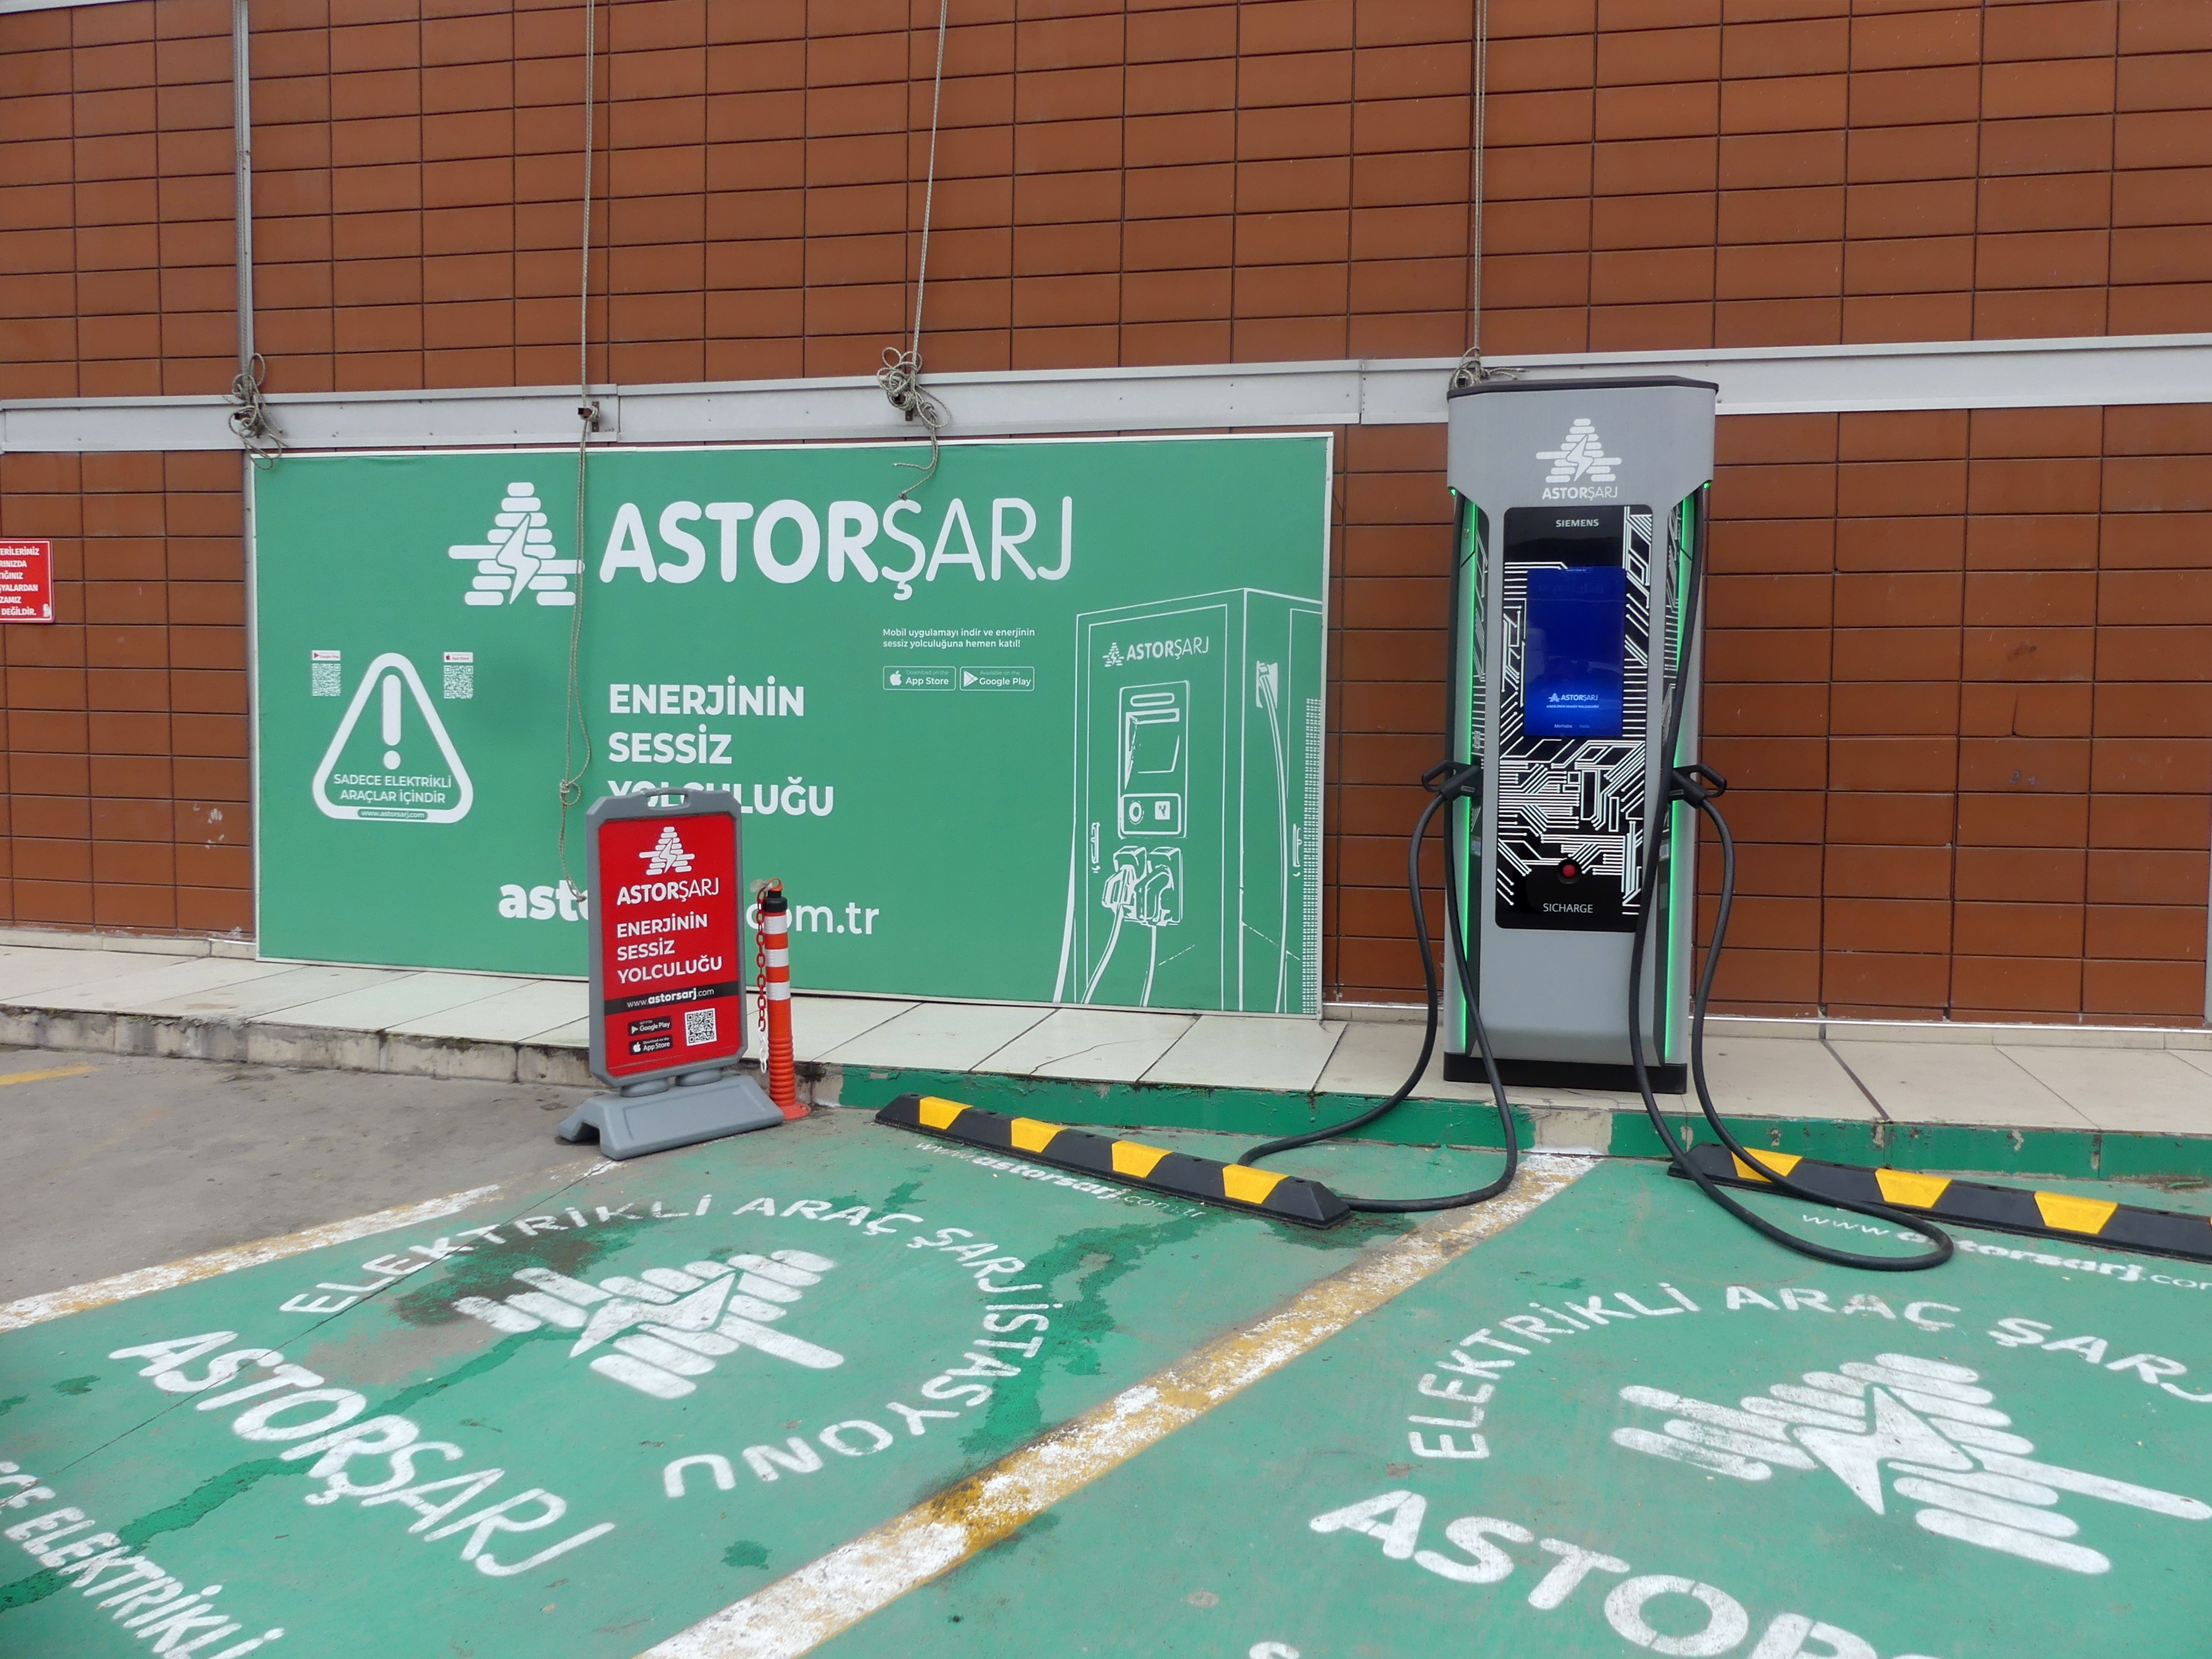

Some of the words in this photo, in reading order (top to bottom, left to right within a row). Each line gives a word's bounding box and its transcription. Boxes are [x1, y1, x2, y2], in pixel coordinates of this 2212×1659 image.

[1542, 486, 1618, 501] ASTORŞARJ
[1556, 519, 1599, 528] SIEMENS
[0, 546, 40, 555] ERİLERİMİZ
[600, 496, 1072, 601] ASTORŞARJ
[883, 628, 906, 637] Mobil
[909, 628, 958, 638] uygulamayı
[961, 628, 982, 637] indir
[995, 628, 1035, 638] enerjinin
[883, 639, 908, 648] sessiz
[910, 639, 963, 649] yolculuğuna
[966, 639, 997, 648] hemen
[999, 639, 1020, 648] katıl!
[1126, 635, 1209, 661] ASTORŞARJ
[905, 677, 924, 686] App
[979, 677, 1010, 687] Google
[1013, 677, 1031, 687] Play
[609, 675, 804, 716] ENERJİNİN
[609, 724, 732, 764] SESSİZ
[333, 774, 382, 786] SADECE
[384, 774, 451, 788] ELEKTRİKLİ
[340, 790, 397, 804] ARAÇLAR
[399, 789, 446, 805] İÇİNDİR
[617, 877, 719, 906] ASTORŞARJ
[1543, 903, 1593, 914] SICHARGE
[617, 911, 708, 938] ENERJİNİN
[617, 937, 675, 961] SESSİZ
[617, 954, 722, 984] YOLCULUĞU
[627, 988, 715, 1008] www.astorsarj.com
[639, 1024, 659, 1032] Google
[643, 1043, 655, 1052] App
[733, 1197, 924, 1237] ARAÇ
[1407, 1282, 1700, 1459] ELEKTRİKLİ
[109, 1330, 615, 1577] ASTORŞARJ
